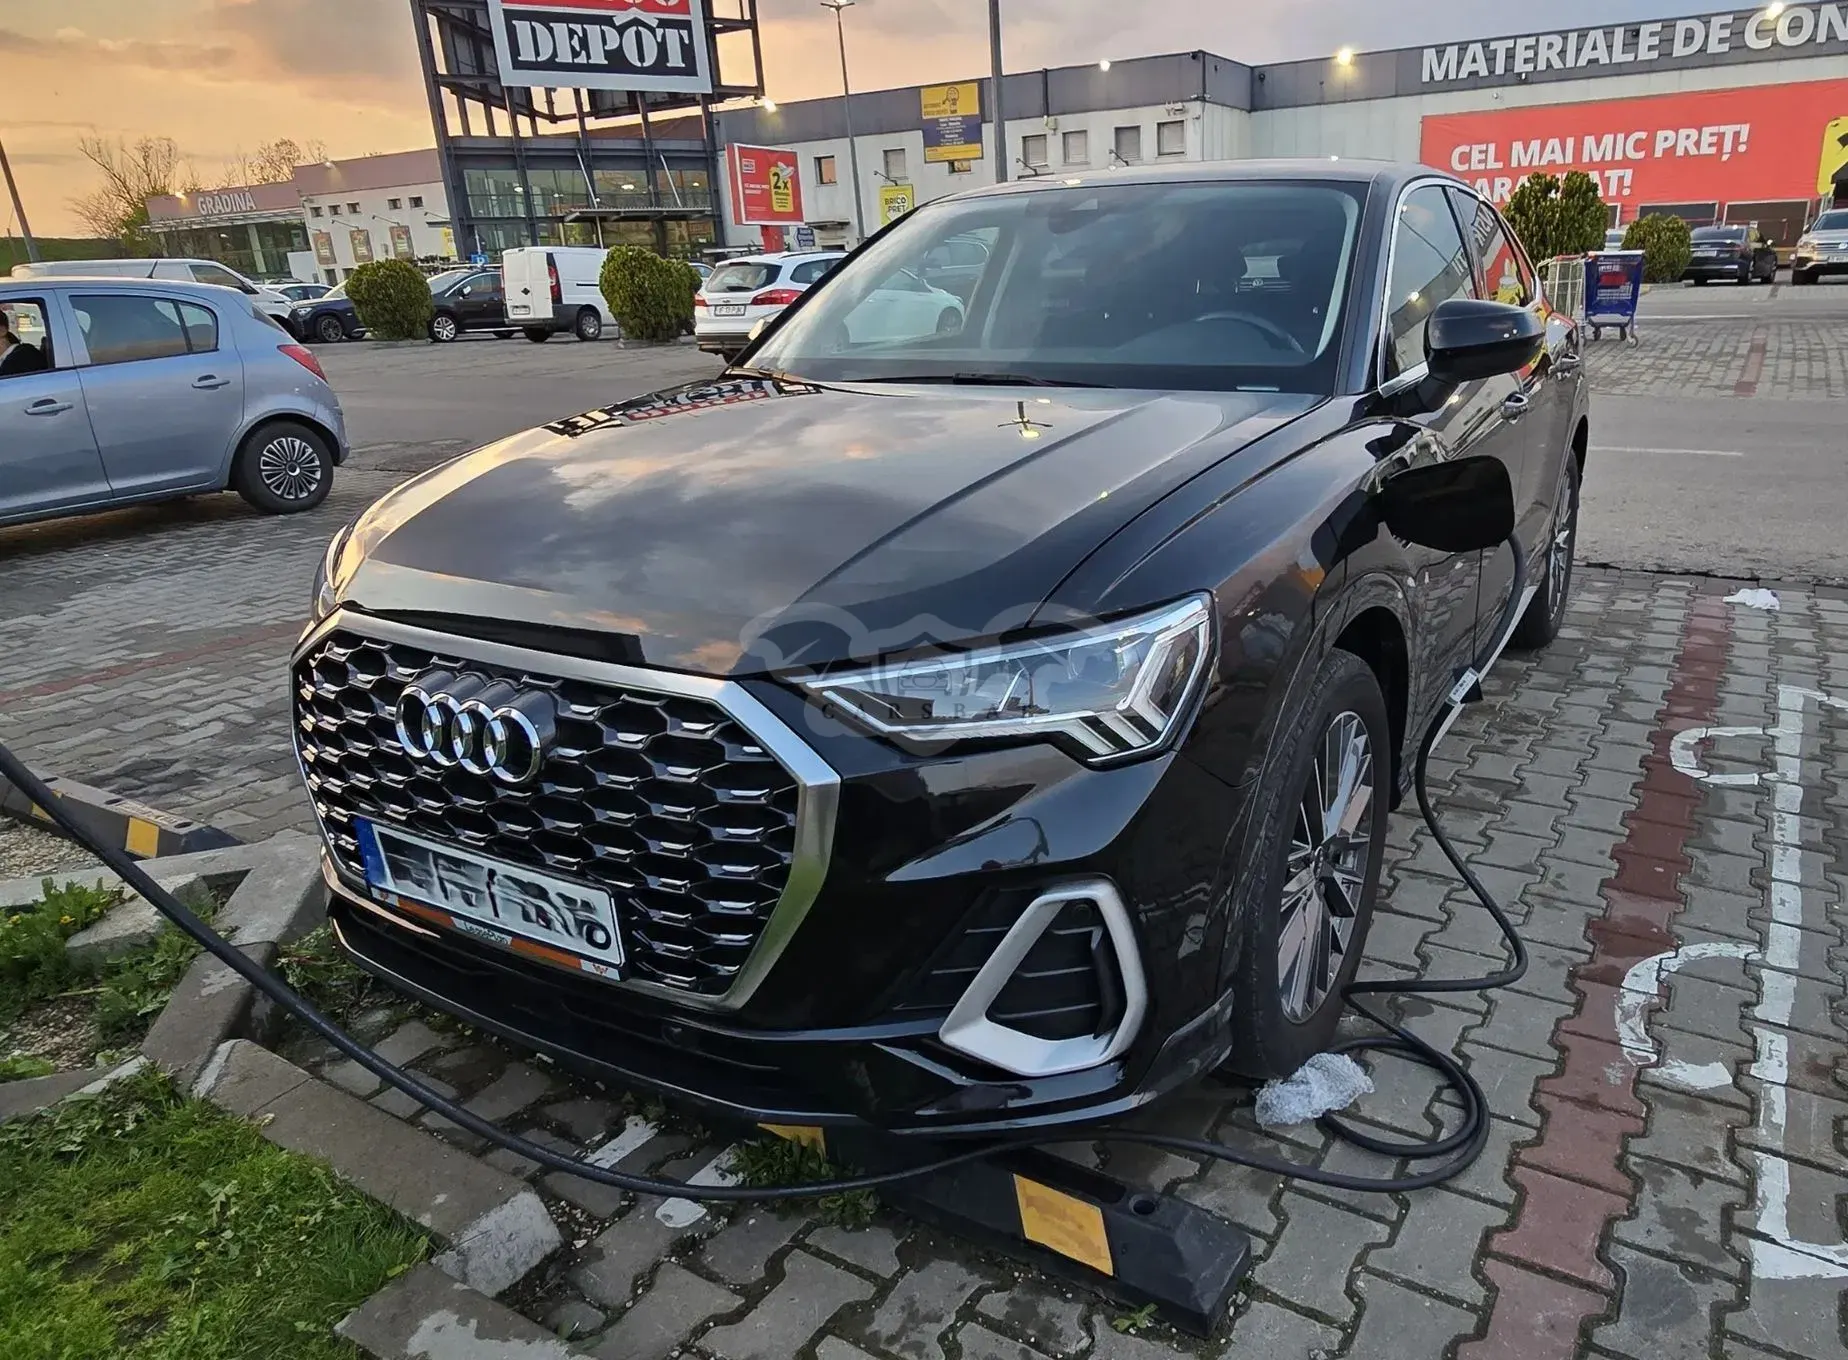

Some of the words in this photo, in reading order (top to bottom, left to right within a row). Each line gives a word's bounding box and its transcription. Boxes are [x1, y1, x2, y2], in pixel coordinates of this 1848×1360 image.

[512, 8, 689, 67] DEPÔT
[1422, 22, 1662, 82] MATERIALE
[1672, 14, 1734, 57] DE
[1744, 3, 1848, 50] CON
[1450, 143, 1503, 171] CEL
[1511, 136, 1574, 168] MAI
[1583, 131, 1648, 162] MIC
[1654, 123, 1750, 162] PREȚ!
